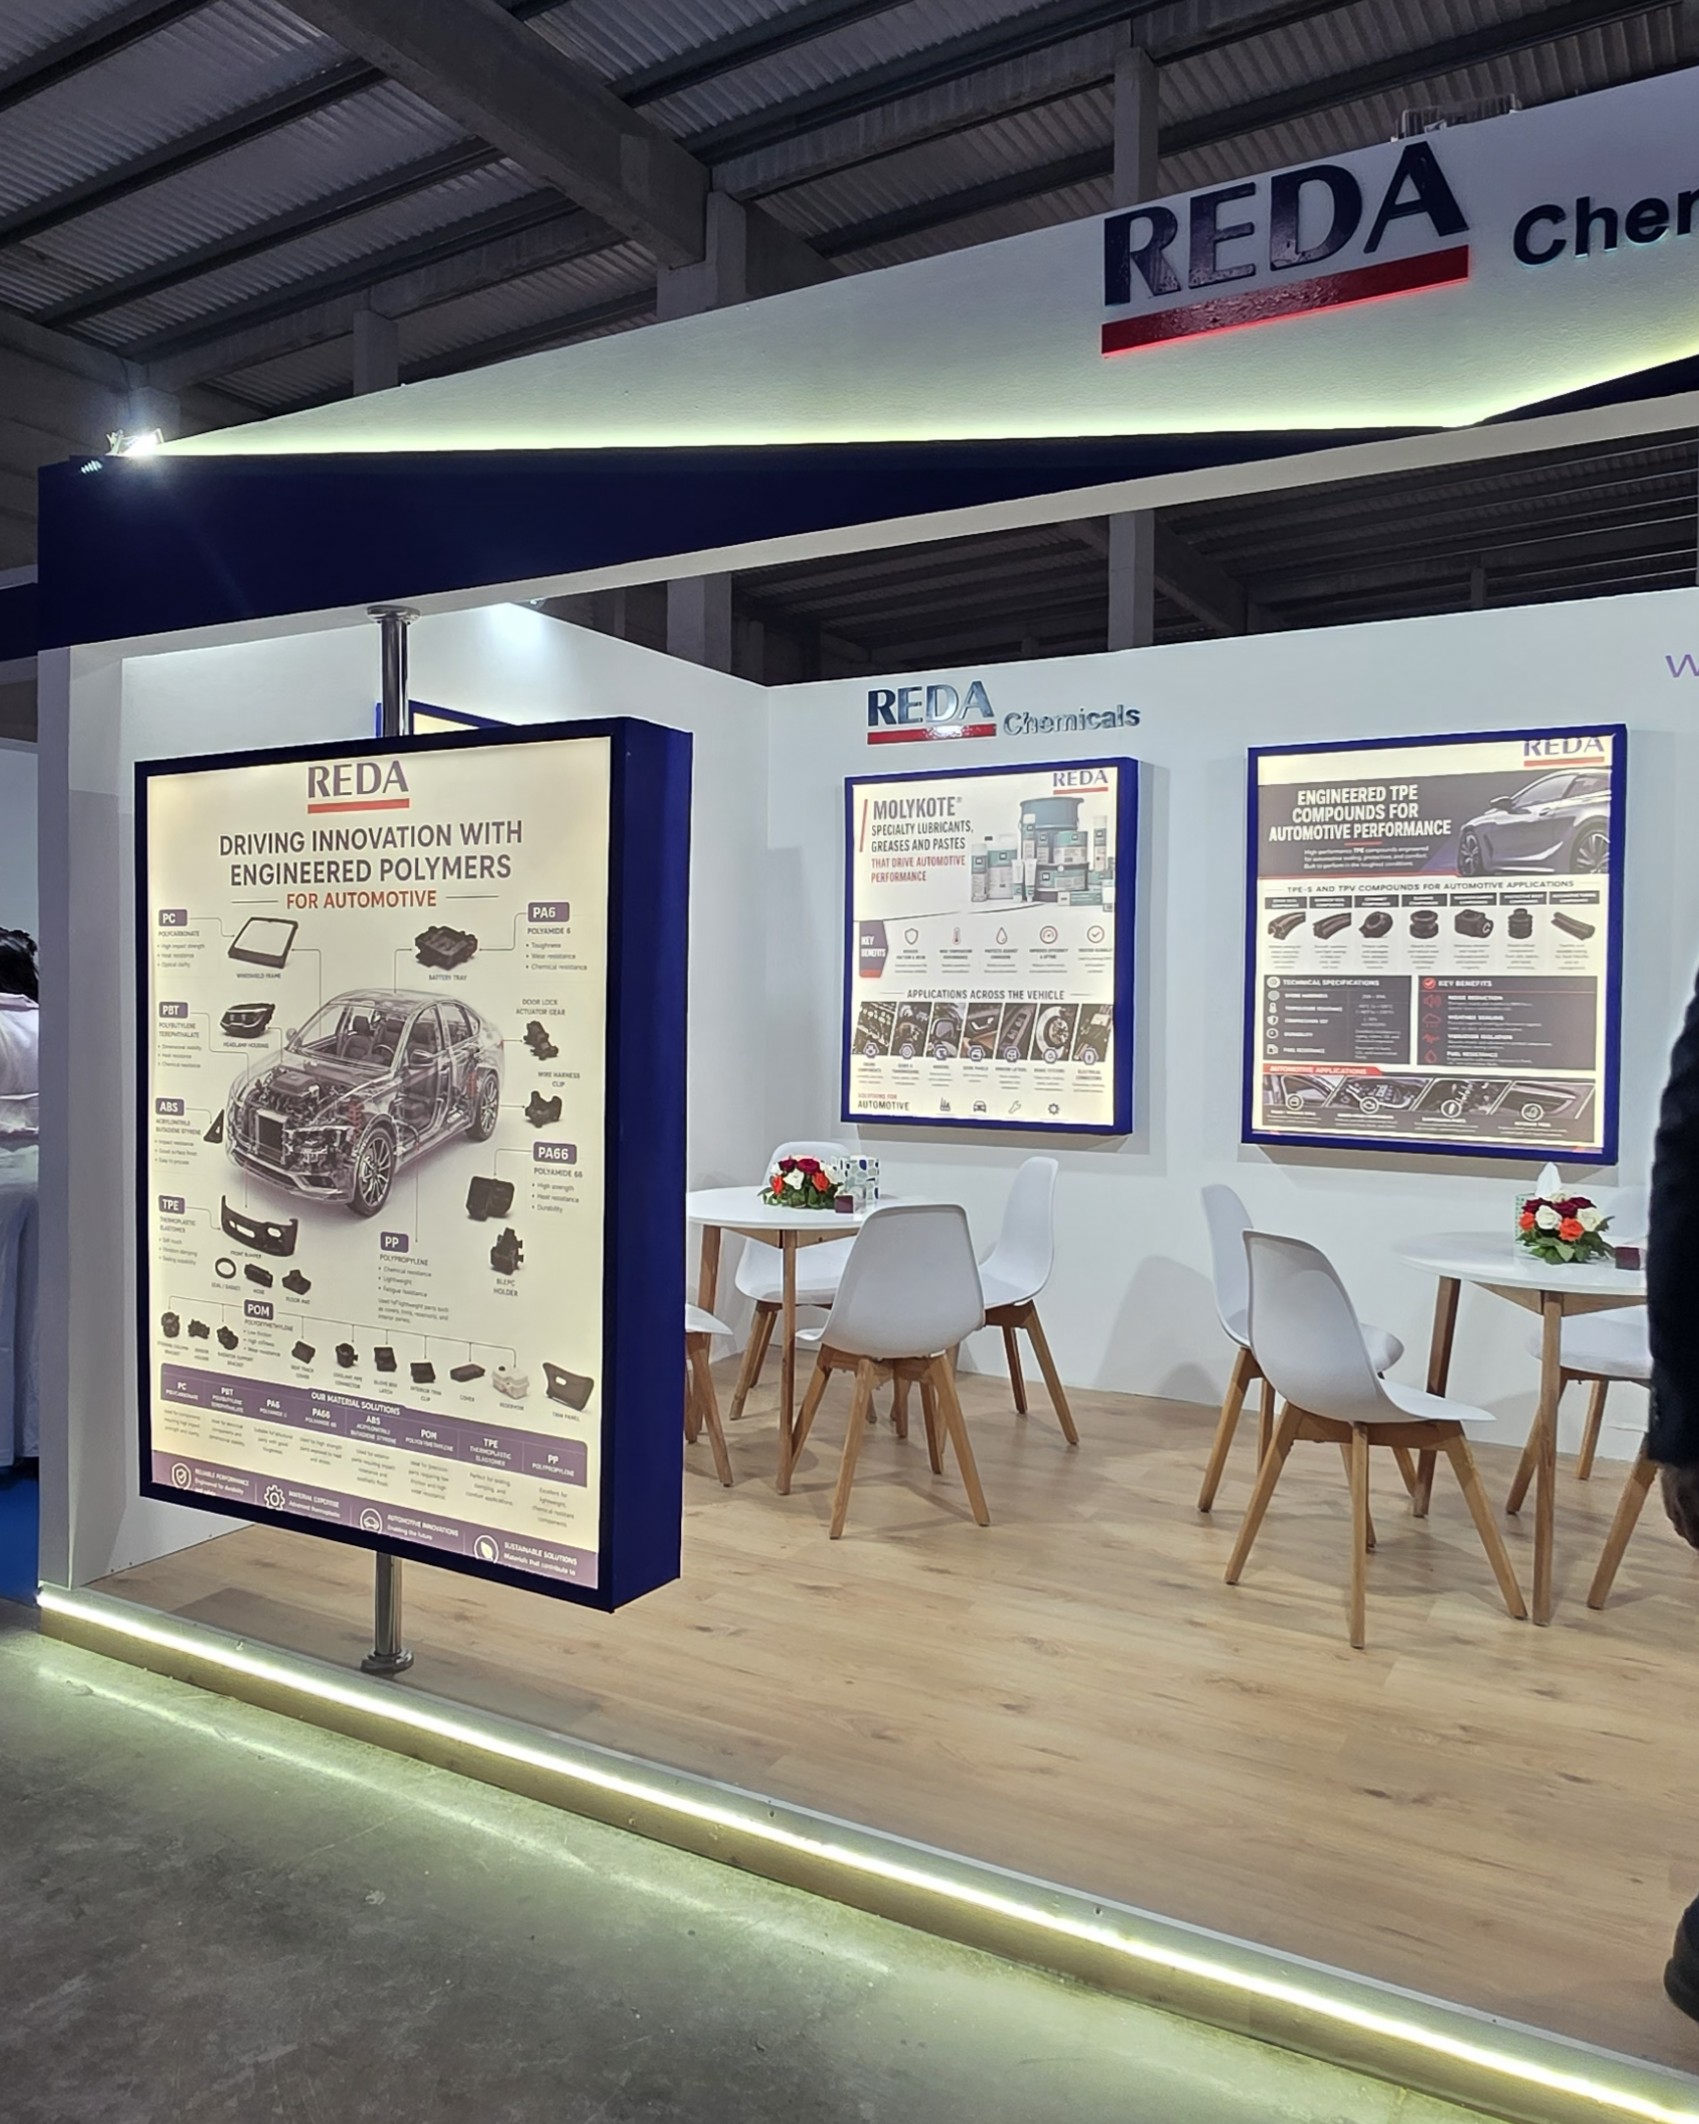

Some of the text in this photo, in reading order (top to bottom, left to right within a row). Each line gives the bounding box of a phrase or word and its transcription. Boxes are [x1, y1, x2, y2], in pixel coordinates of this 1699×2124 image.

[1104, 141, 1470, 306] REDA
[868, 680, 1141, 736] REDA Chemicals
[1523, 738, 1604, 757] REDA
[307, 760, 409, 798] REDA
[1053, 769, 1109, 787] REDA
[1297, 784, 1418, 806] ENGINEERED TPE
[1292, 801, 1418, 823] COMPOUNDS FOR
[871, 820, 974, 836] SPECIALTY LUBRICANTS,
[1268, 818, 1452, 842] AUTOMOTIVE PERFORMANCE
[219, 820, 523, 856] DRIVING INNOVATION WITH
[871, 837, 966, 853] GREASES AND PASTES
[871, 855, 966, 869] THAT DRIVE AUTOMOTIVE
[230, 854, 511, 887] ENGINEERED POLYMERS
[871, 871, 927, 883] PERFORMANCE
[1287, 879, 1574, 894] TPE-S AND TPV COMPOUNDS FOR AUTOMOTIVE APPLICATIONS
[286, 889, 437, 910] FOR AUTOMOTIVE
[162, 913, 176, 923] PC
[532, 907, 556, 919] PA6
[527, 927, 565, 935] POLYAMIDE
[861, 936, 875, 946] KEY
[861, 948, 886, 958] BENEFITS
[1283, 979, 1380, 987] TECHNICAL SPECIFICATIONS
[907, 989, 1065, 1000] APPLICATIONS ACROSS THE VEHICLE
[162, 1005, 179, 1015] PBT
[159, 1101, 178, 1112] ABS
[858, 1100, 910, 1111] AUTOMOTIVE
[538, 1146, 569, 1160] PA66
[162, 1199, 179, 1211] TPE
[385, 1237, 399, 1248] PP
[247, 1304, 270, 1317] POM
[266, 1399, 280, 1409] PA6
[311, 1391, 401, 1415] OUR MATERIAL SOLUTIONS
[312, 1408, 331, 1419] PA66
[366, 1415, 381, 1425] ABS
[421, 1429, 437, 1440] POM
[483, 1438, 499, 1449] TPE
[547, 1454, 559, 1465] PP
